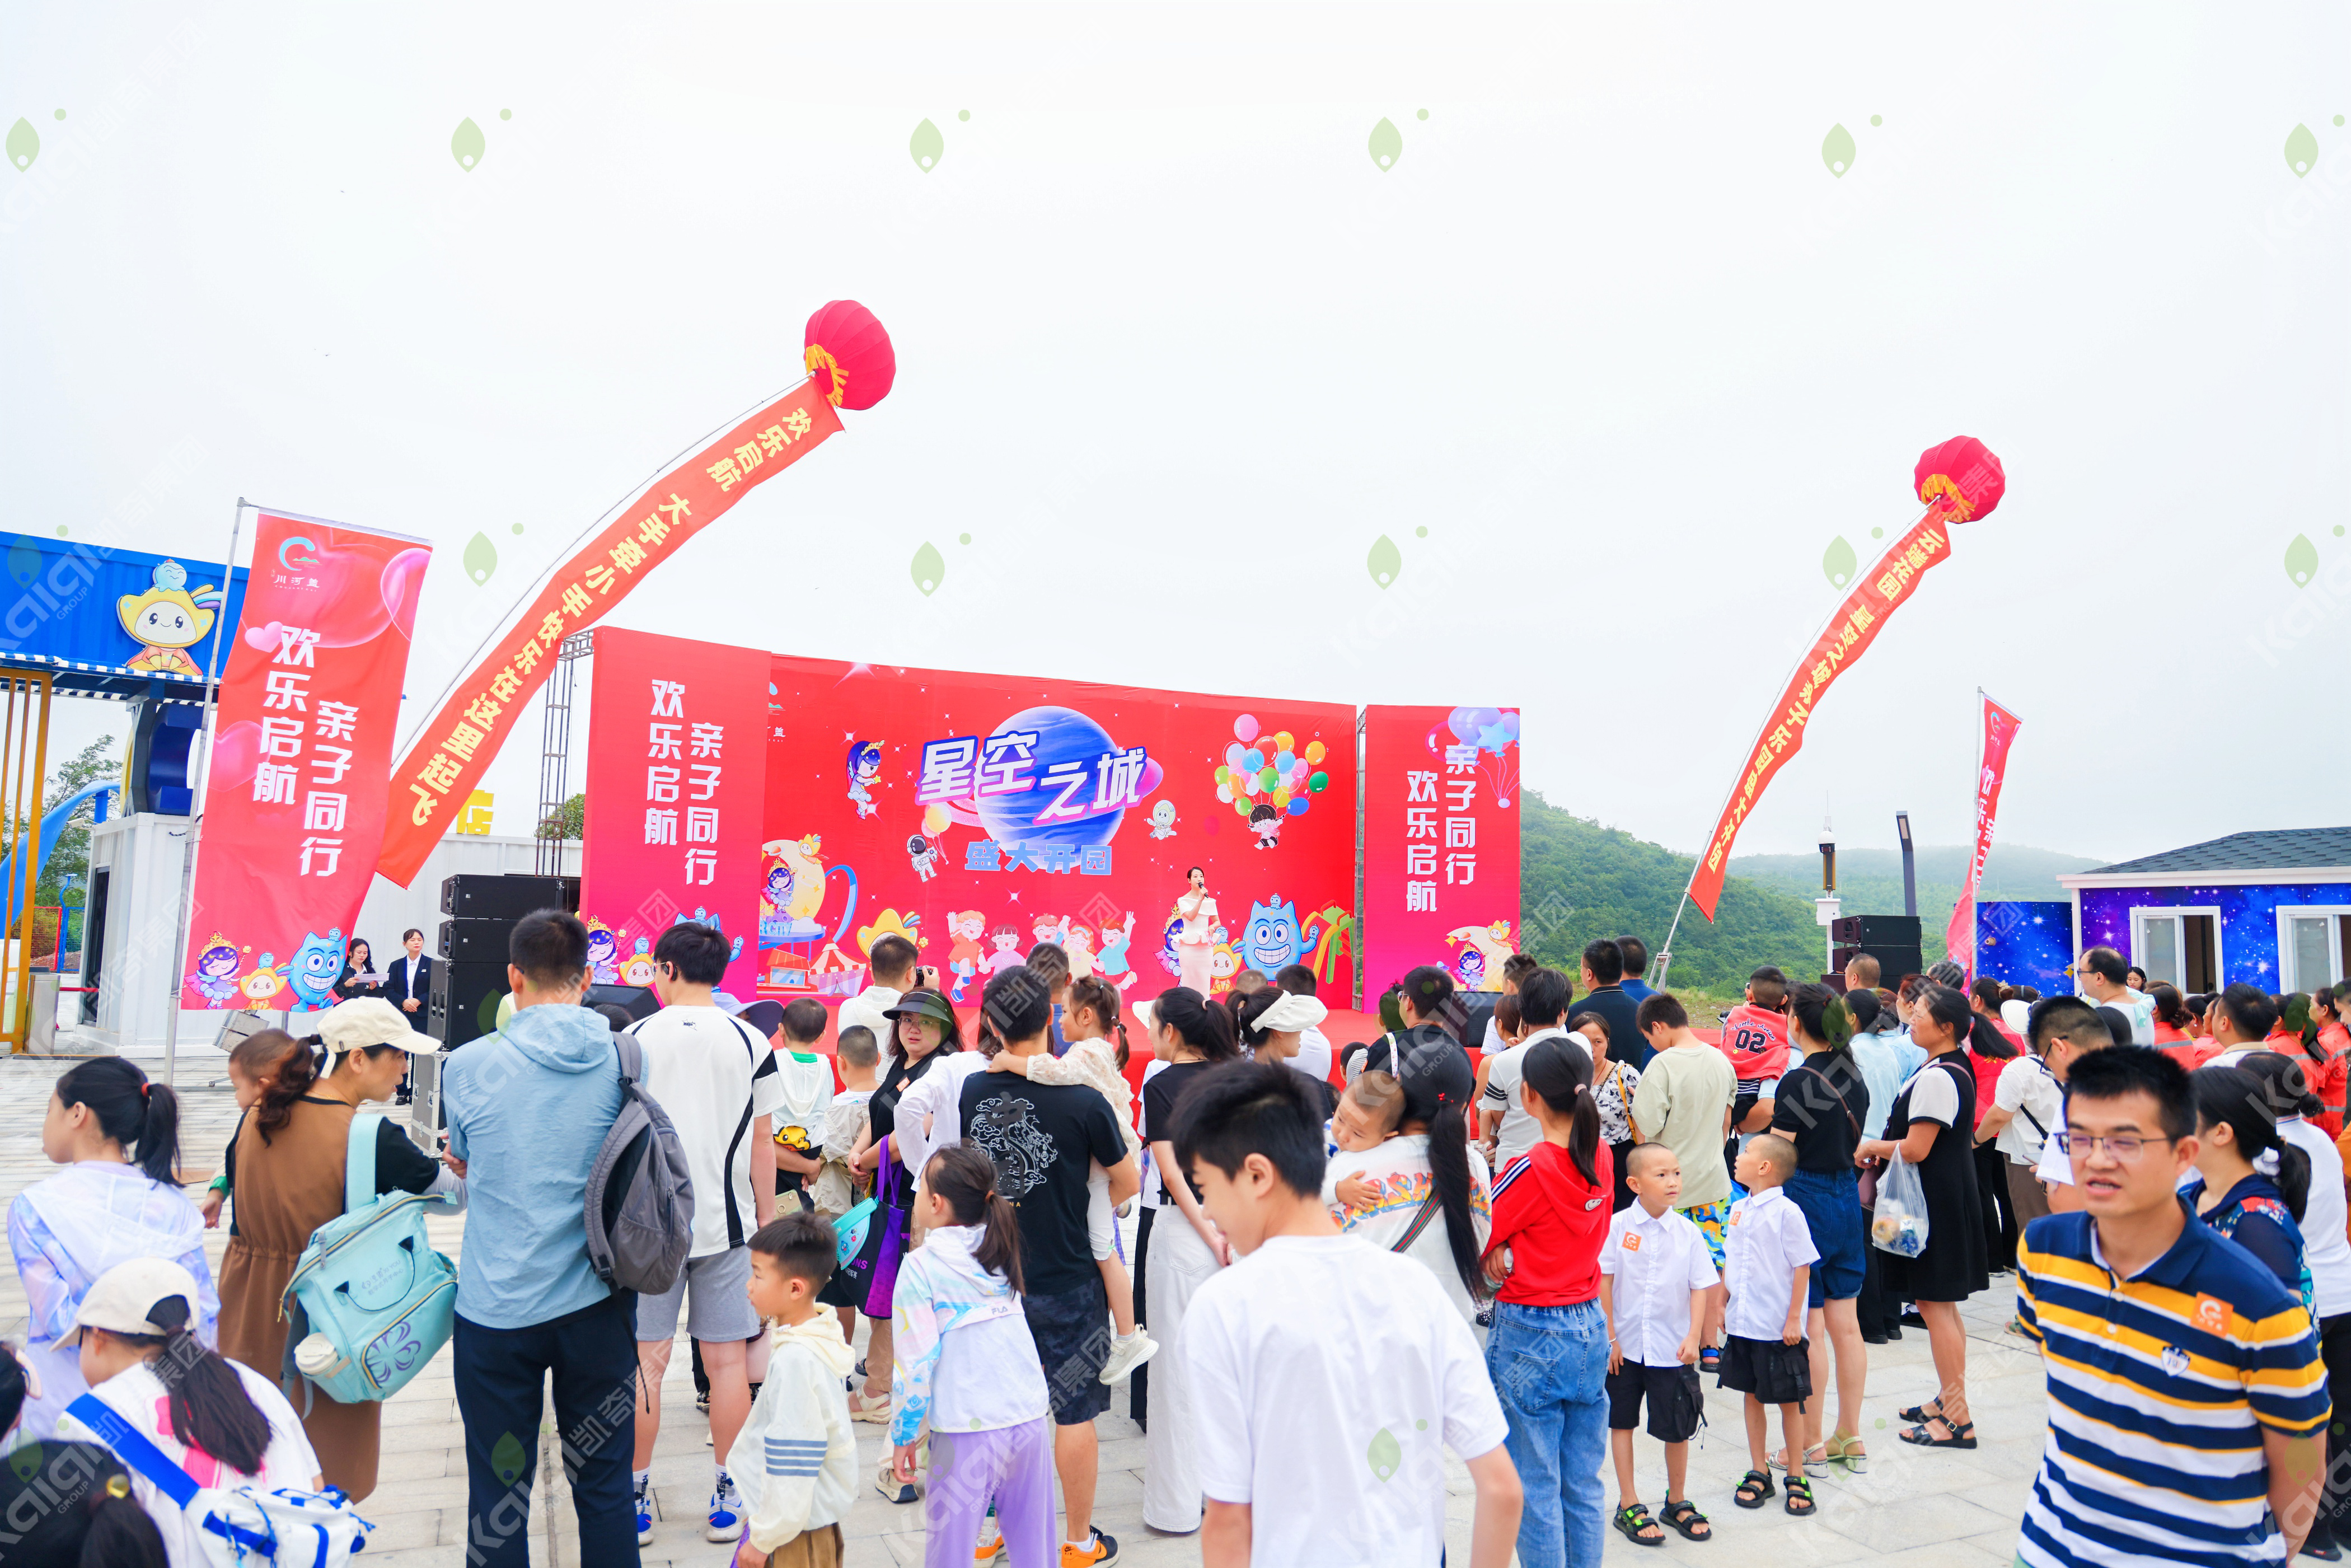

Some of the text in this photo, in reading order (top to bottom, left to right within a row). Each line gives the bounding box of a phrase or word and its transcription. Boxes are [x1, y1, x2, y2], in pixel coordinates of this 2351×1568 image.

[706, 407, 812, 492] 欢乐启航
[273, 574, 320, 588] 川河盖
[1876, 528, 1945, 601] 云端花园
[253, 625, 321, 805] 欢乐启航
[409, 493, 692, 826] 大手牵小手快乐在这里起飞
[299, 701, 359, 877] 亲子同行
[645, 679, 685, 846] 欢乐启航
[685, 722, 724, 886] 亲子同行
[917, 731, 1147, 824] 星空之城
[1445, 744, 1477, 885] 亲子同行
[964, 840, 1112, 876] 盛大开园
[1406, 770, 1438, 912] 欢乐启航
[1735, 1029, 1767, 1054] 02
